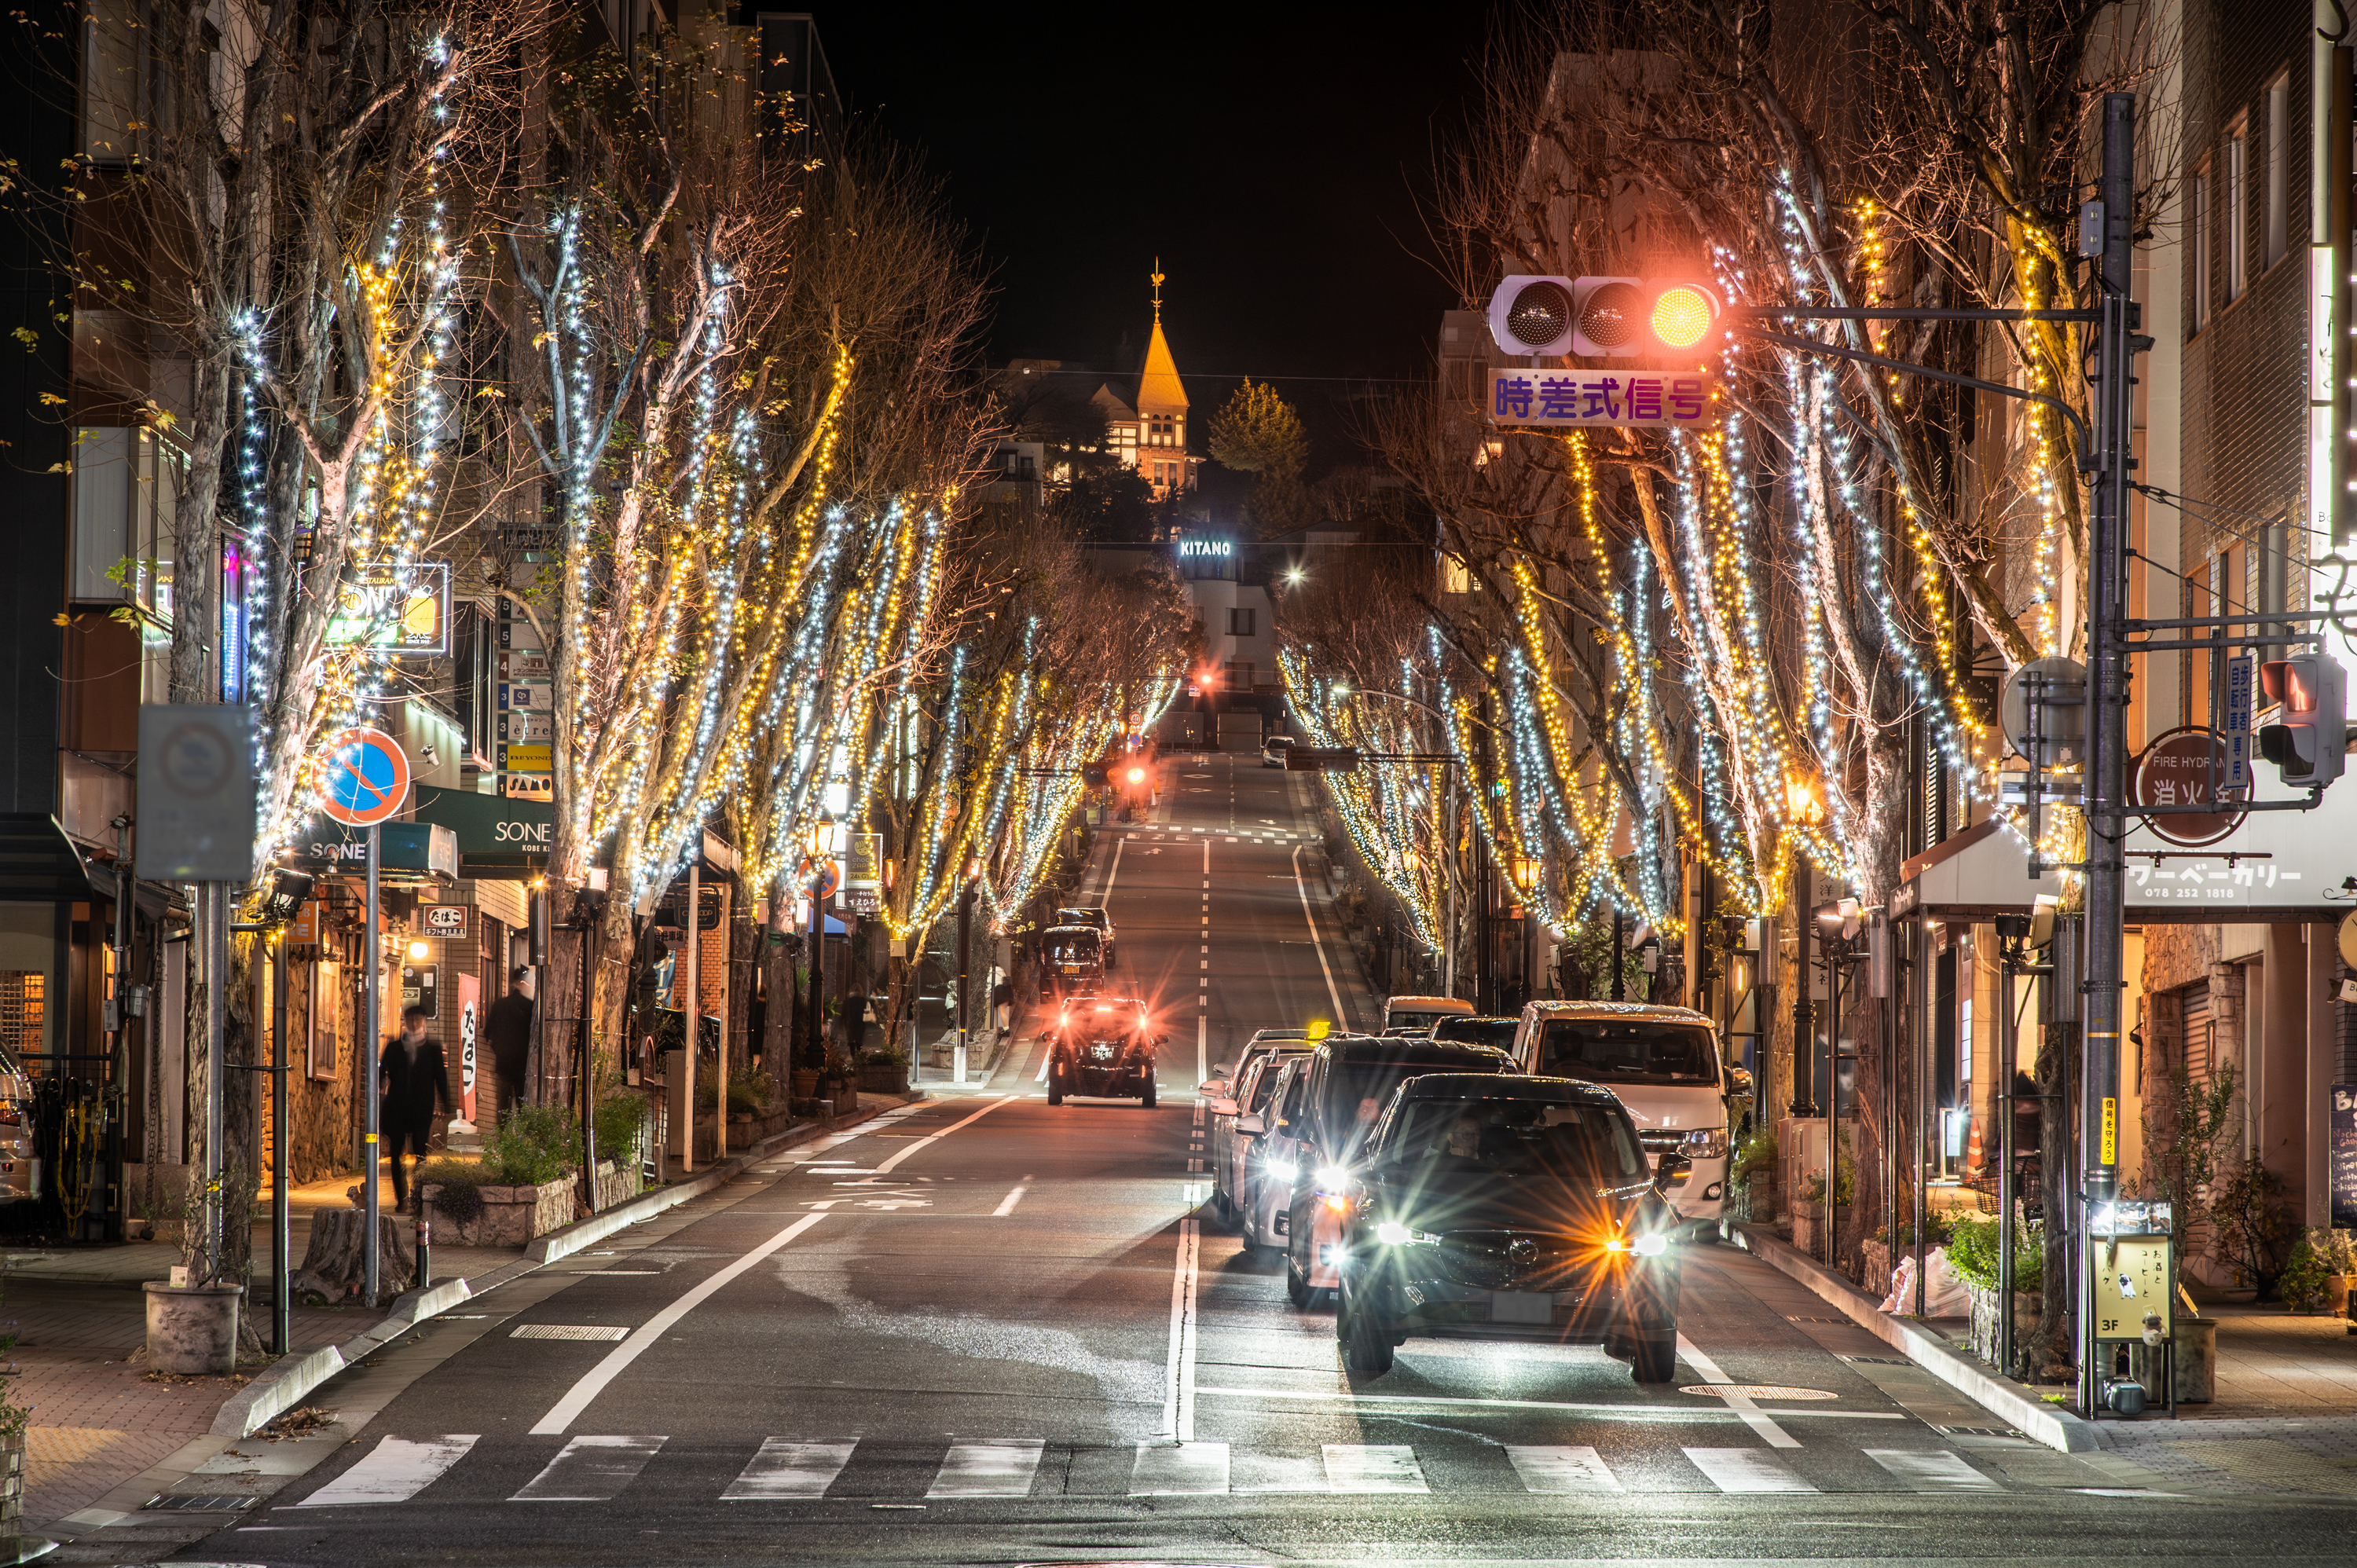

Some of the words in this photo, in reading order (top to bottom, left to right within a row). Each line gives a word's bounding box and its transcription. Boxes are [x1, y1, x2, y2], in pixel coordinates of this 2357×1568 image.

[1494, 377, 1706, 420] 時差式信号
[1181, 542, 1230, 556] KITANO
[503, 601, 510, 611] 5
[502, 631, 509, 640] 5
[500, 661, 508, 672] 4
[1980, 681, 1993, 693] AND
[2239, 665, 2249, 731] 歩行者
[500, 723, 507, 732] 3
[499, 752, 507, 763] 3
[2154, 757, 2177, 768] FIRE
[500, 783, 504, 792] 1
[494, 822, 552, 841] SONE
[2145, 888, 2169, 898] 078
[2176, 888, 2199, 898] 252
[2206, 888, 2234, 898] 1818
[431, 910, 460, 922] たばこ
[2153, 1250, 2162, 1284] お酒と
[2102, 1320, 2118, 1331] 3F
